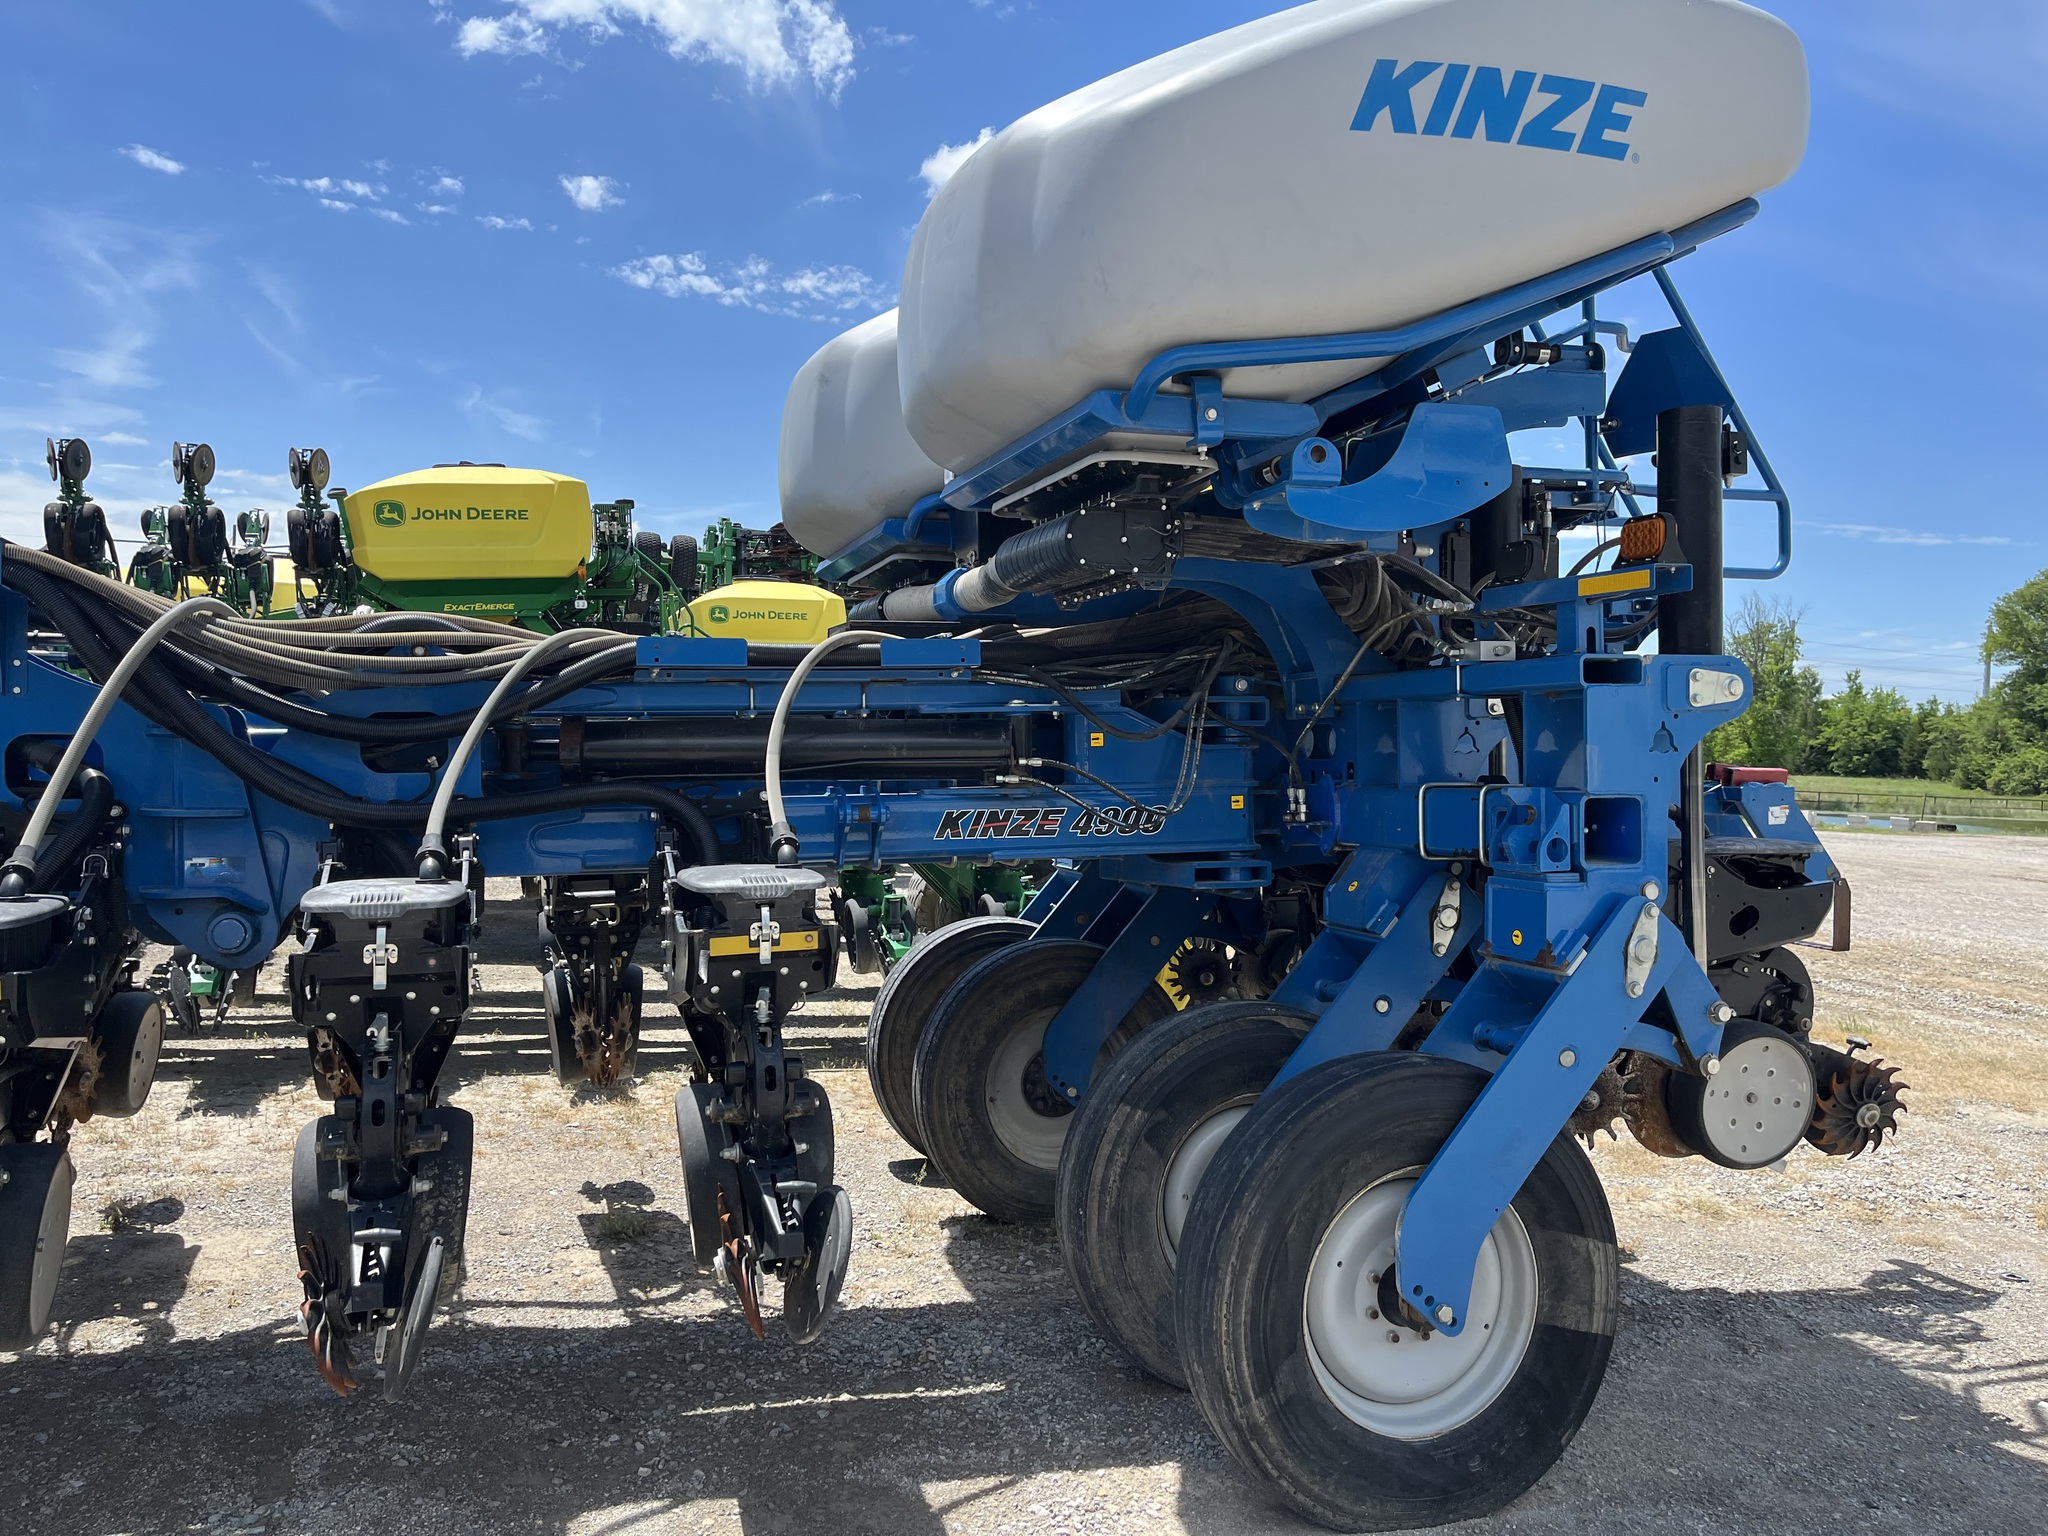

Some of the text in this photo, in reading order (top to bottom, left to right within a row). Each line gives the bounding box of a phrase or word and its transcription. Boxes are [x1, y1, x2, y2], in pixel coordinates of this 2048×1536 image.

[1350, 58, 1648, 161] KINZE
[411, 507, 528, 520] JOHN DEERE
[733, 610, 807, 620] JOHN DEERE
[934, 808, 1067, 840] KINZE
